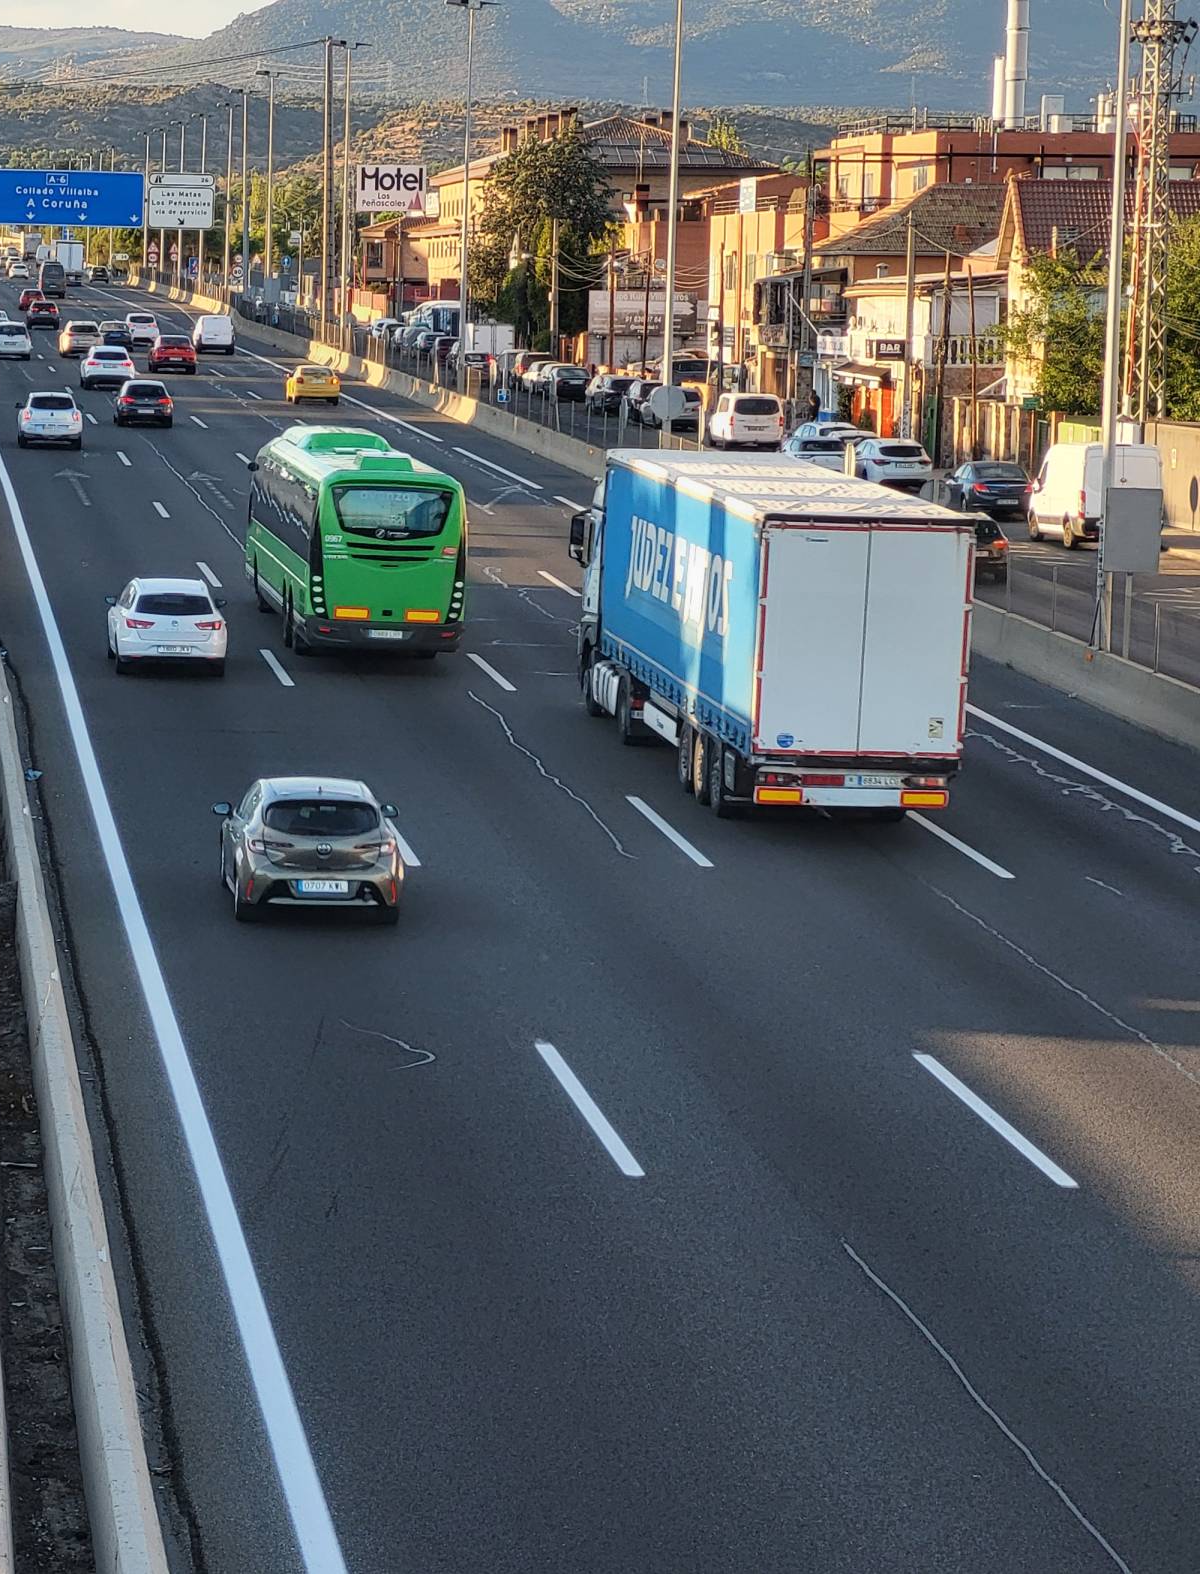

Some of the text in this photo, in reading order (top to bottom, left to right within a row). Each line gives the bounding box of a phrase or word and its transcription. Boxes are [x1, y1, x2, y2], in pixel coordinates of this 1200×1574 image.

[48, 175, 67, 184] A-6
[15, 186, 99, 196] Collado Villalba
[377, 192, 390, 200] Los
[26, 198, 88, 209] A Coruña
[362, 199, 406, 207] Peñascales
[879, 343, 901, 351] BAR
